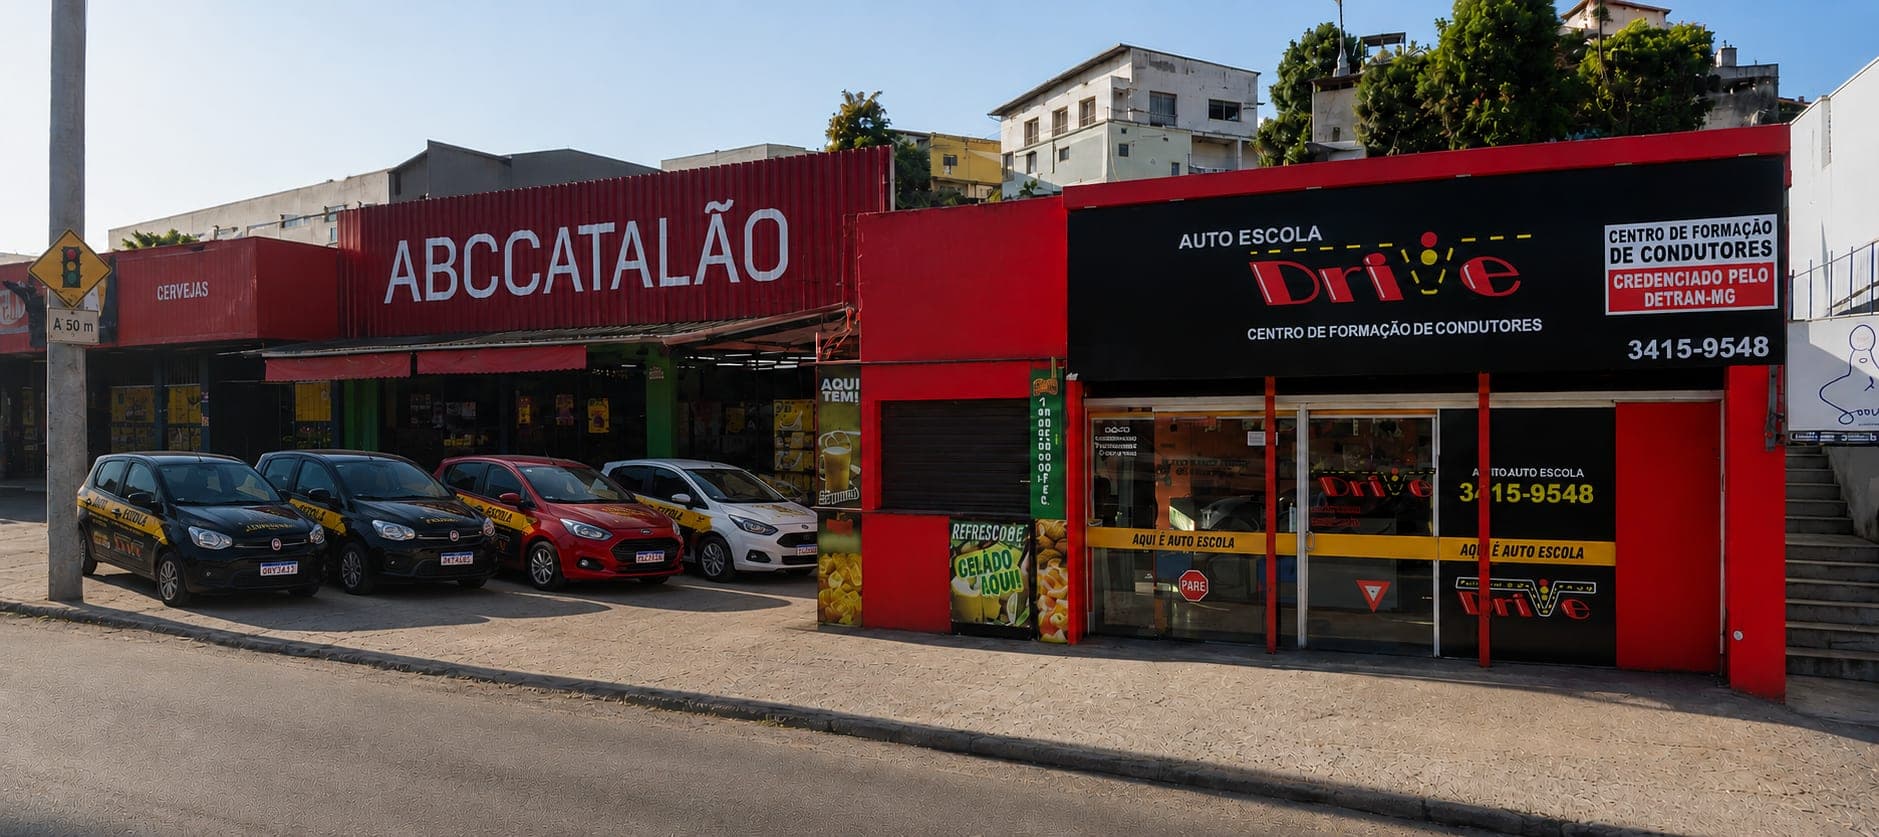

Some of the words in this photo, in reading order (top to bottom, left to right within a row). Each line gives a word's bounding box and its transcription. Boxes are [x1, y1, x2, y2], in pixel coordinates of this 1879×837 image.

[1179, 231, 1233, 249] AUTO
[1239, 225, 1323, 245] ESCOLA
[1609, 227, 1665, 243] CENTRO
[1670, 226, 1687, 241] DE
[1693, 218, 1773, 240] FORMAÇÃO
[384, 199, 788, 304] ABCCATALÃO
[1610, 247, 1633, 264] DE
[1641, 240, 1773, 263] CONDUTORES
[1613, 269, 1723, 289] CREDENCIADO
[1728, 267, 1769, 284] PELO
[157, 281, 209, 301] CERVEJAS
[1644, 288, 1736, 307] DETRAN-MG
[53, 317, 62, 330] A
[66, 319, 80, 332] 50
[83, 322, 94, 332] m
[1247, 326, 1304, 340] CENTRO
[1307, 326, 1326, 339] DE
[1329, 320, 1411, 339] FORMAÇÃO
[1413, 322, 1433, 335] DE
[1435, 318, 1543, 334] CONDUTORES
[1628, 336, 1769, 360] 3415-9548
[821, 377, 860, 391] AQUI
[822, 390, 859, 403] TEM!
[1540, 468, 1584, 478] ESCOLA
[1459, 482, 1594, 503] 315-9548
[1132, 533, 1156, 547] AQUI
[1159, 531, 1166, 545] É
[1167, 535, 1194, 548] AUTO
[1197, 536, 1235, 549] ESCOLA
[1460, 544, 1483, 559] AQ
[1492, 541, 1500, 557] É
[1502, 545, 1535, 557] AUTO
[1538, 546, 1584, 559] ESCOLA
[981, 569, 1022, 595] AQUI!
[1181, 579, 1206, 592] PARE
